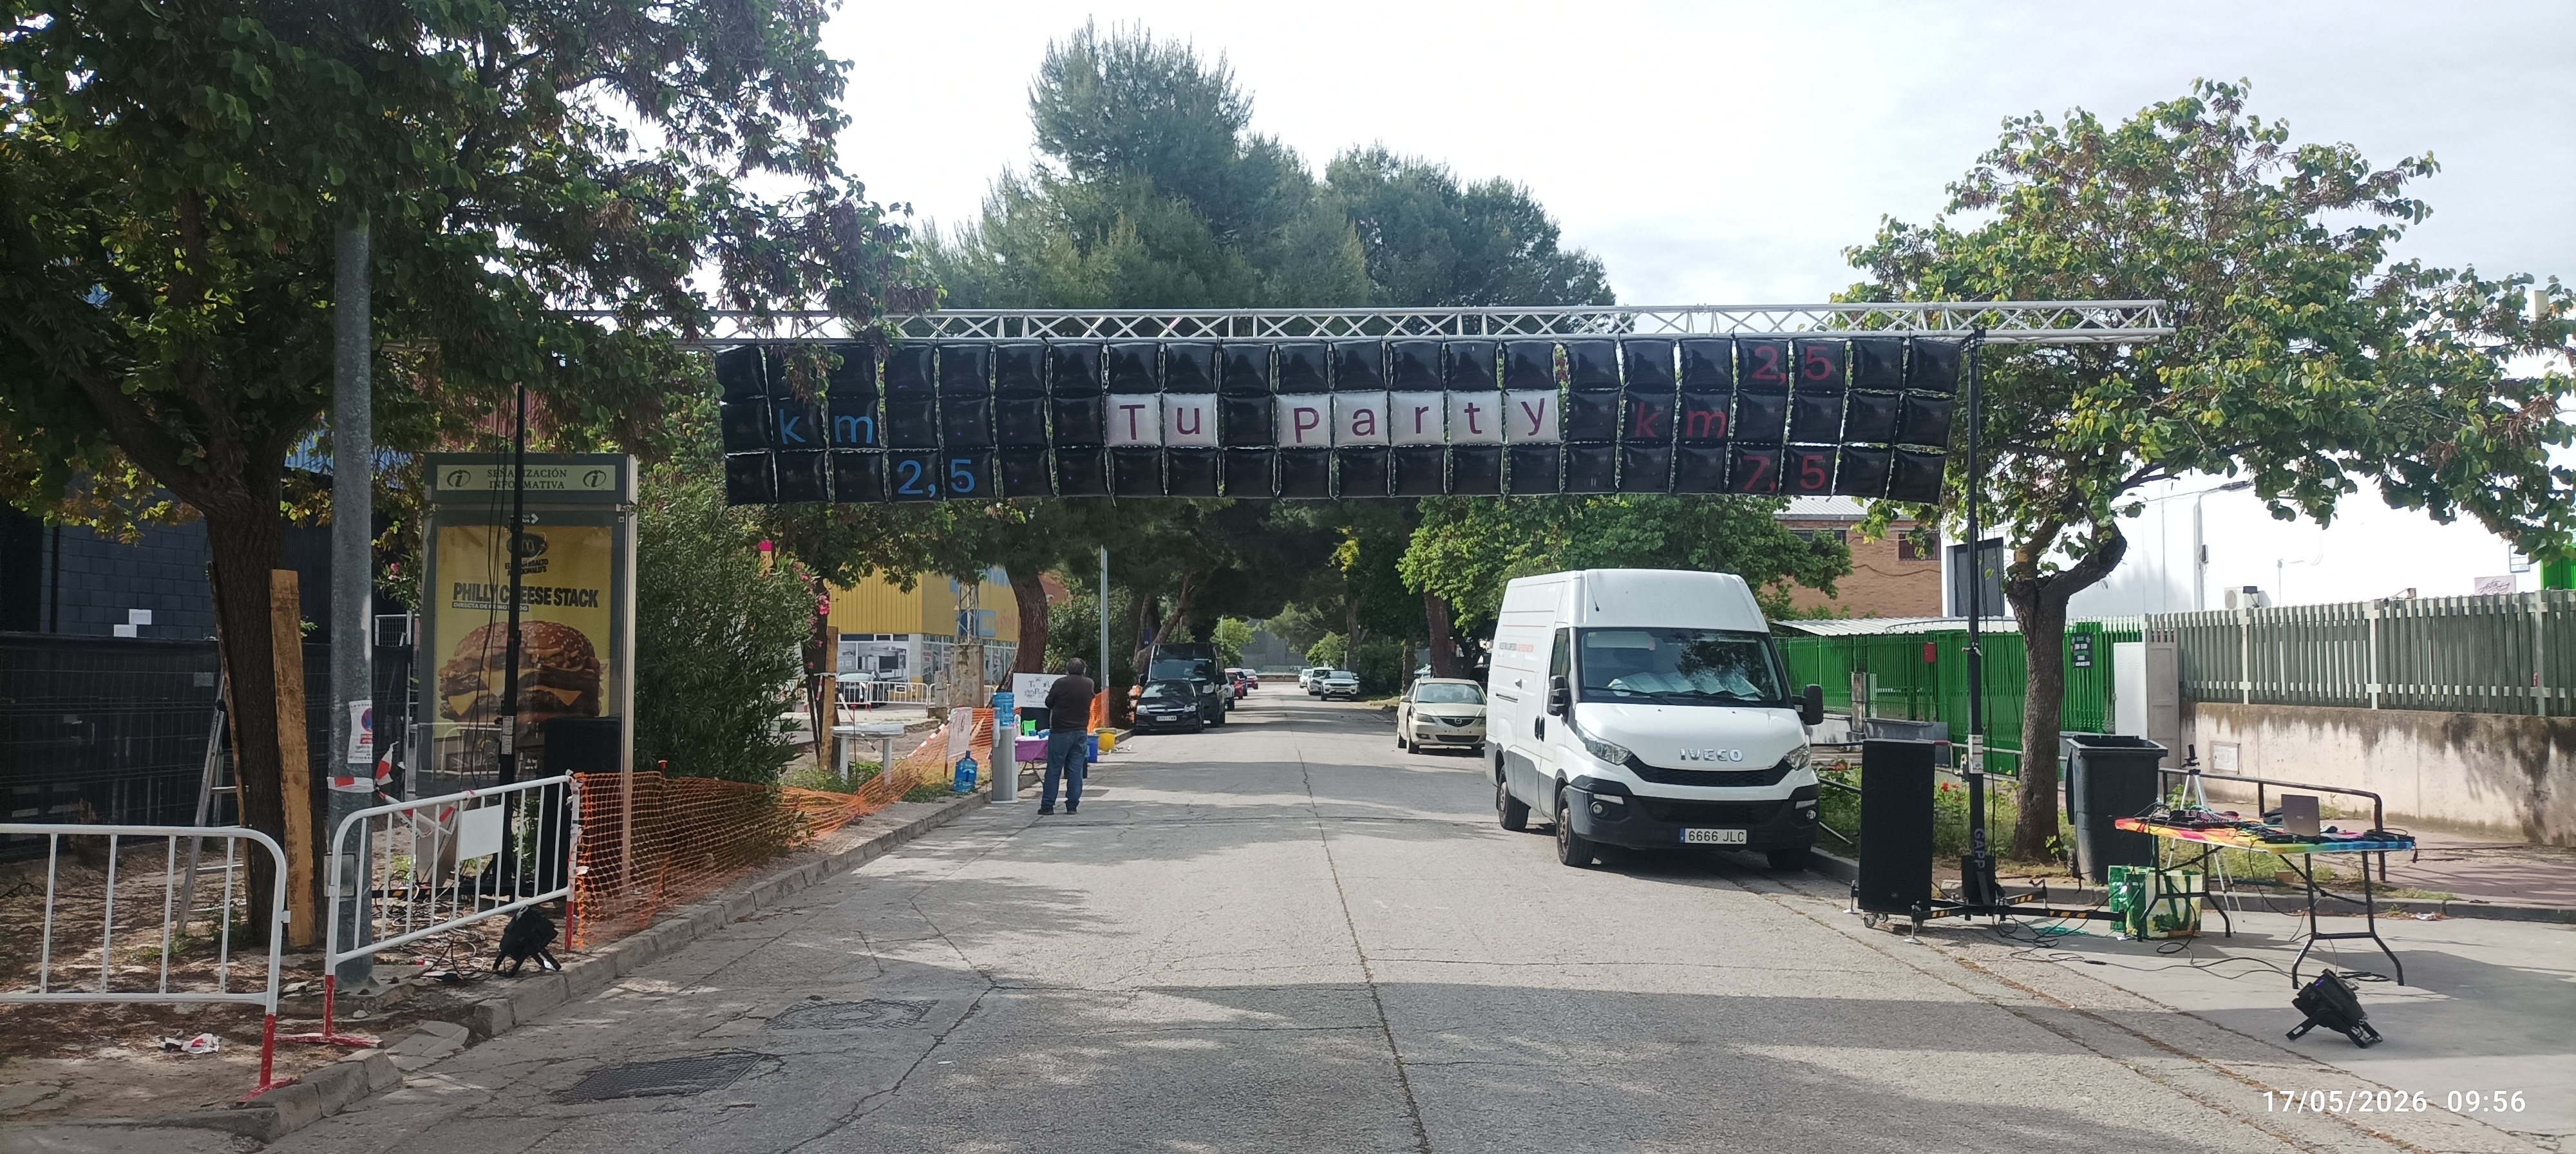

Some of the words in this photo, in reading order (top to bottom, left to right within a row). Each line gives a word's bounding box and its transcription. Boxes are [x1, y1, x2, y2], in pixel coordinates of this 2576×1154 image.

[1751, 345, 1832, 386] 2,5
[779, 408, 873, 444] km
[1119, 404, 1201, 440] Tu
[1293, 398, 1546, 443] Party
[1634, 402, 1727, 439] km
[487, 468, 567, 478] SEÑAIZACIÓN
[489, 480, 565, 489] INFOMATIVA
[897, 459, 975, 498] 2,5
[1742, 455, 1826, 493] 7,5
[453, 582, 498, 602] PHILLY
[499, 584, 553, 606] CEESE
[553, 587, 600, 608] STACK
[1680, 748, 1743, 762] IVECO
[1689, 830, 1719, 842] 6666
[1722, 831, 1745, 843] JLC
[1974, 828, 1985, 869] GAPP
